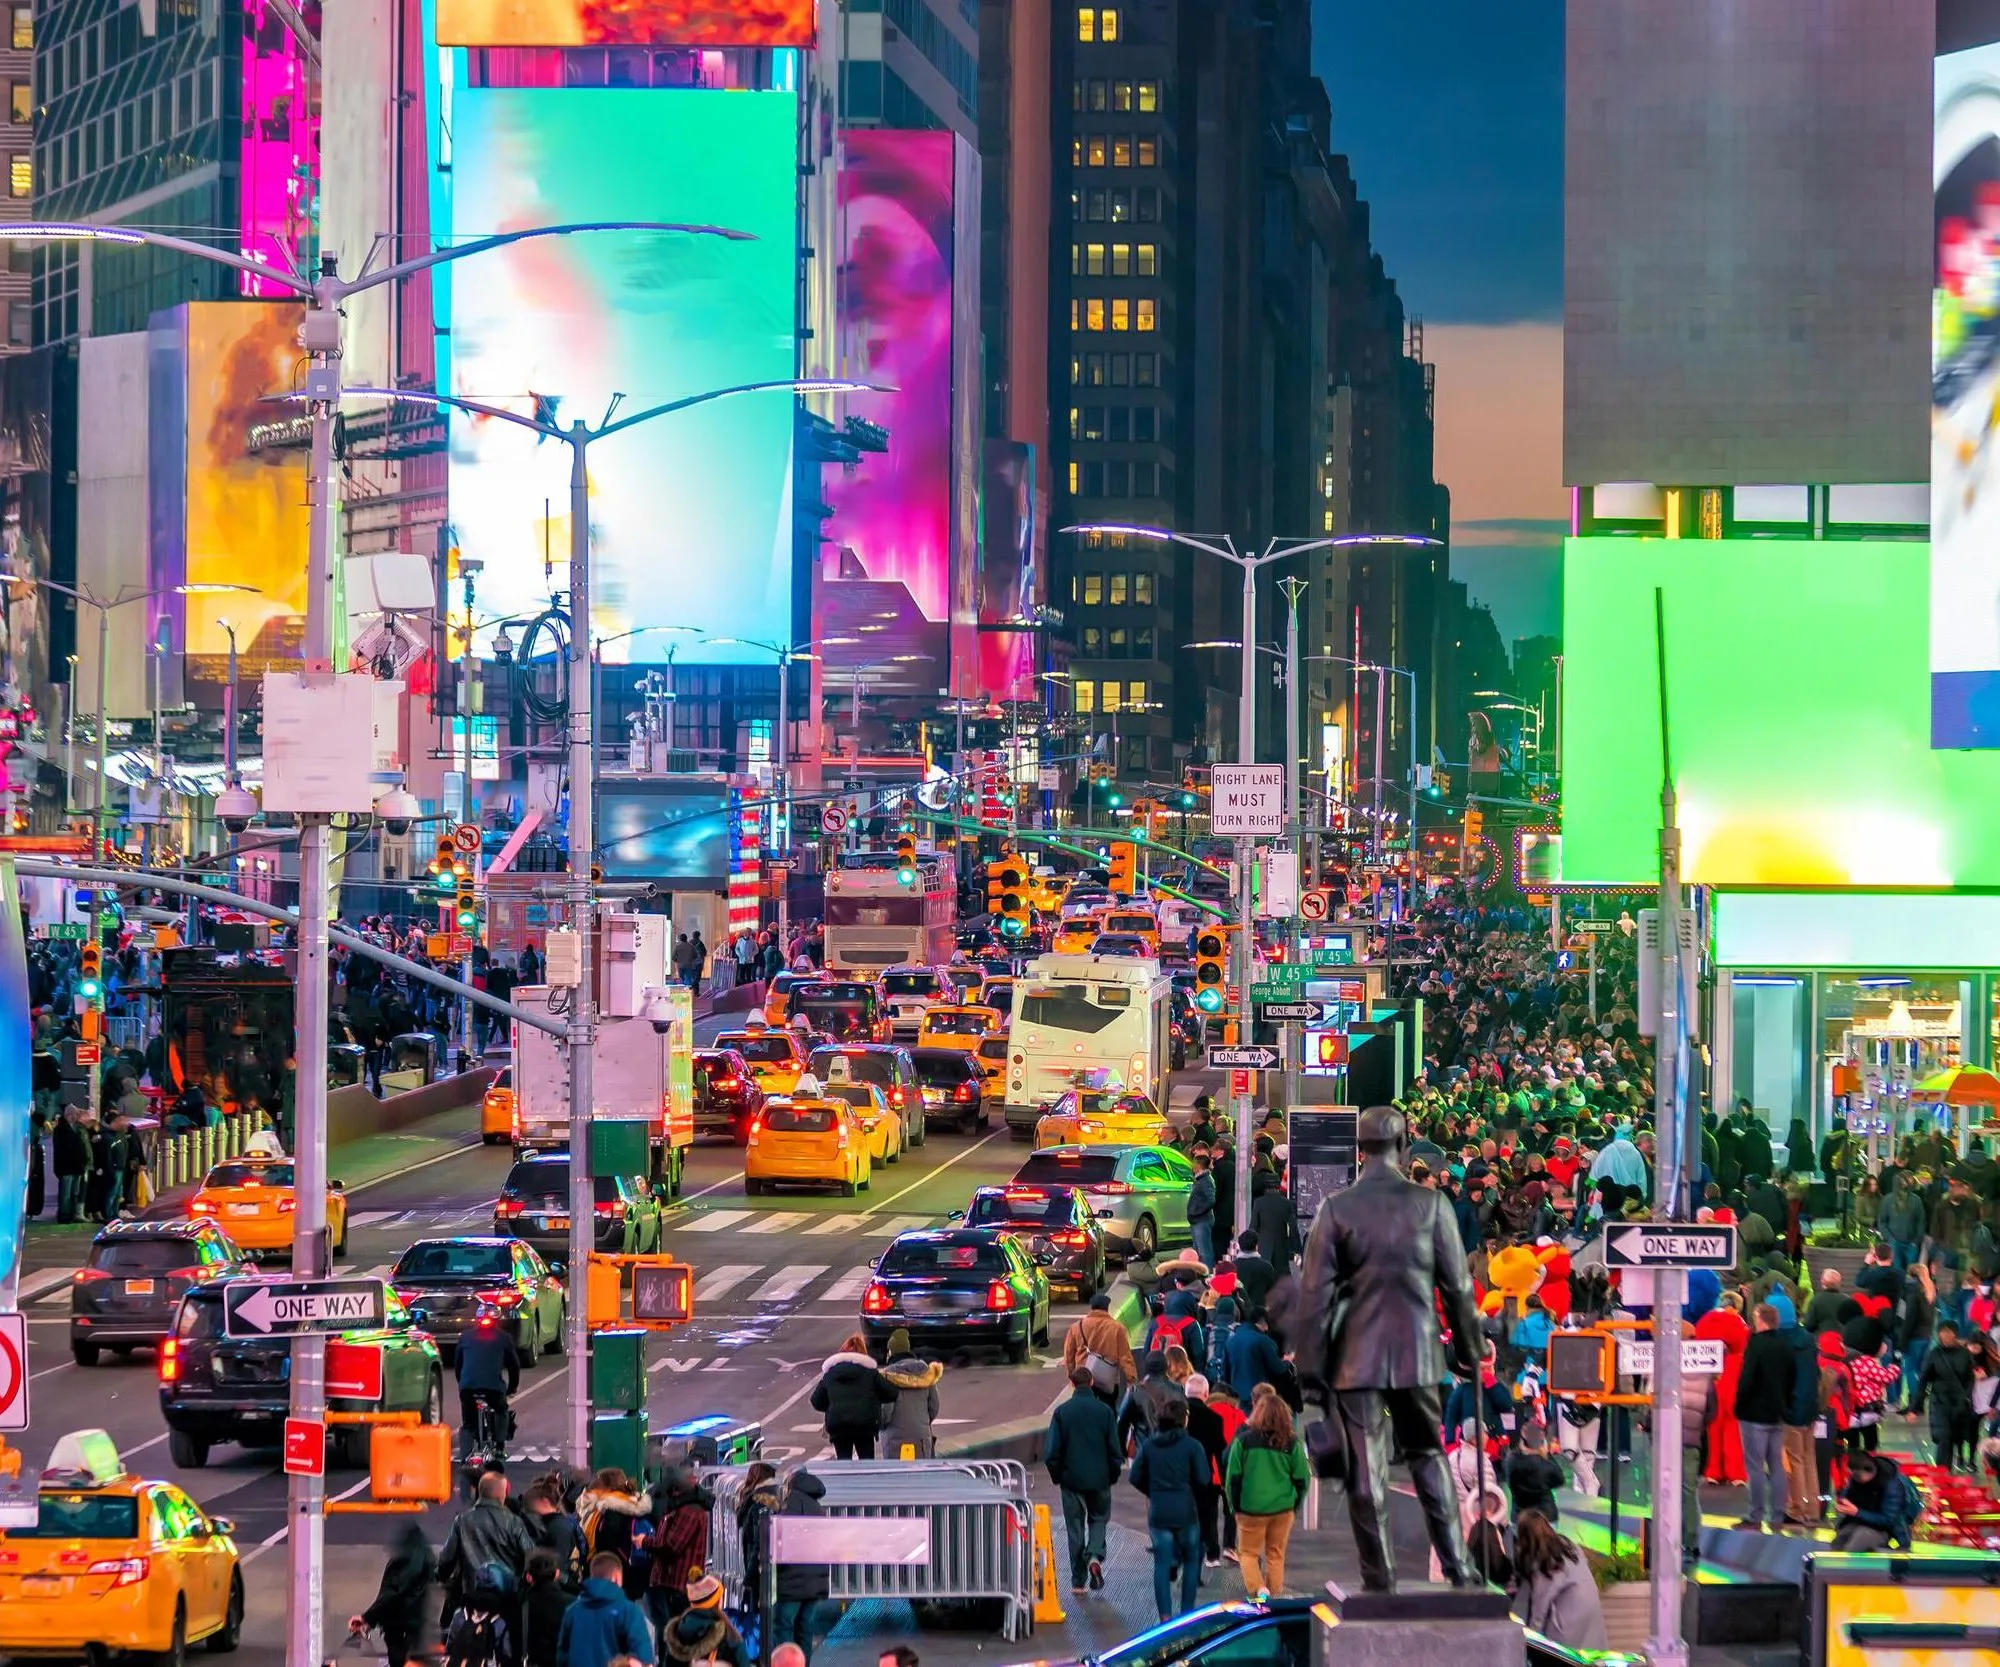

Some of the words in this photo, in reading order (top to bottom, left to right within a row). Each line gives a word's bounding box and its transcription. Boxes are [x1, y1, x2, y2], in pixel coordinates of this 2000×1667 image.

[1215, 774, 1247, 785] RIGHT
[1252, 774, 1280, 785] LANE
[1228, 793, 1266, 807] MUST
[1215, 815, 1242, 826] TURN
[1248, 815, 1280, 826] RIGHT
[51, 925, 60, 937] W
[64, 925, 77, 938] 45
[1314, 950, 1324, 962] W
[1328, 950, 1341, 962] 45
[1270, 967, 1281, 980] W
[1286, 967, 1300, 980] 45
[1251, 986, 1271, 997] George
[1272, 986, 1291, 996] Abbott
[1271, 1007, 1289, 1015] ONE
[1296, 1007, 1315, 1015] WAY
[1219, 1053, 1239, 1062] ONE
[1248, 1053, 1270, 1062] WAY
[1644, 1238, 1678, 1254] ONE
[1685, 1238, 1721, 1255] WAY
[274, 1298, 316, 1319] ONE
[325, 1295, 367, 1317] WAY
[646, 1357, 826, 1373] NLY
